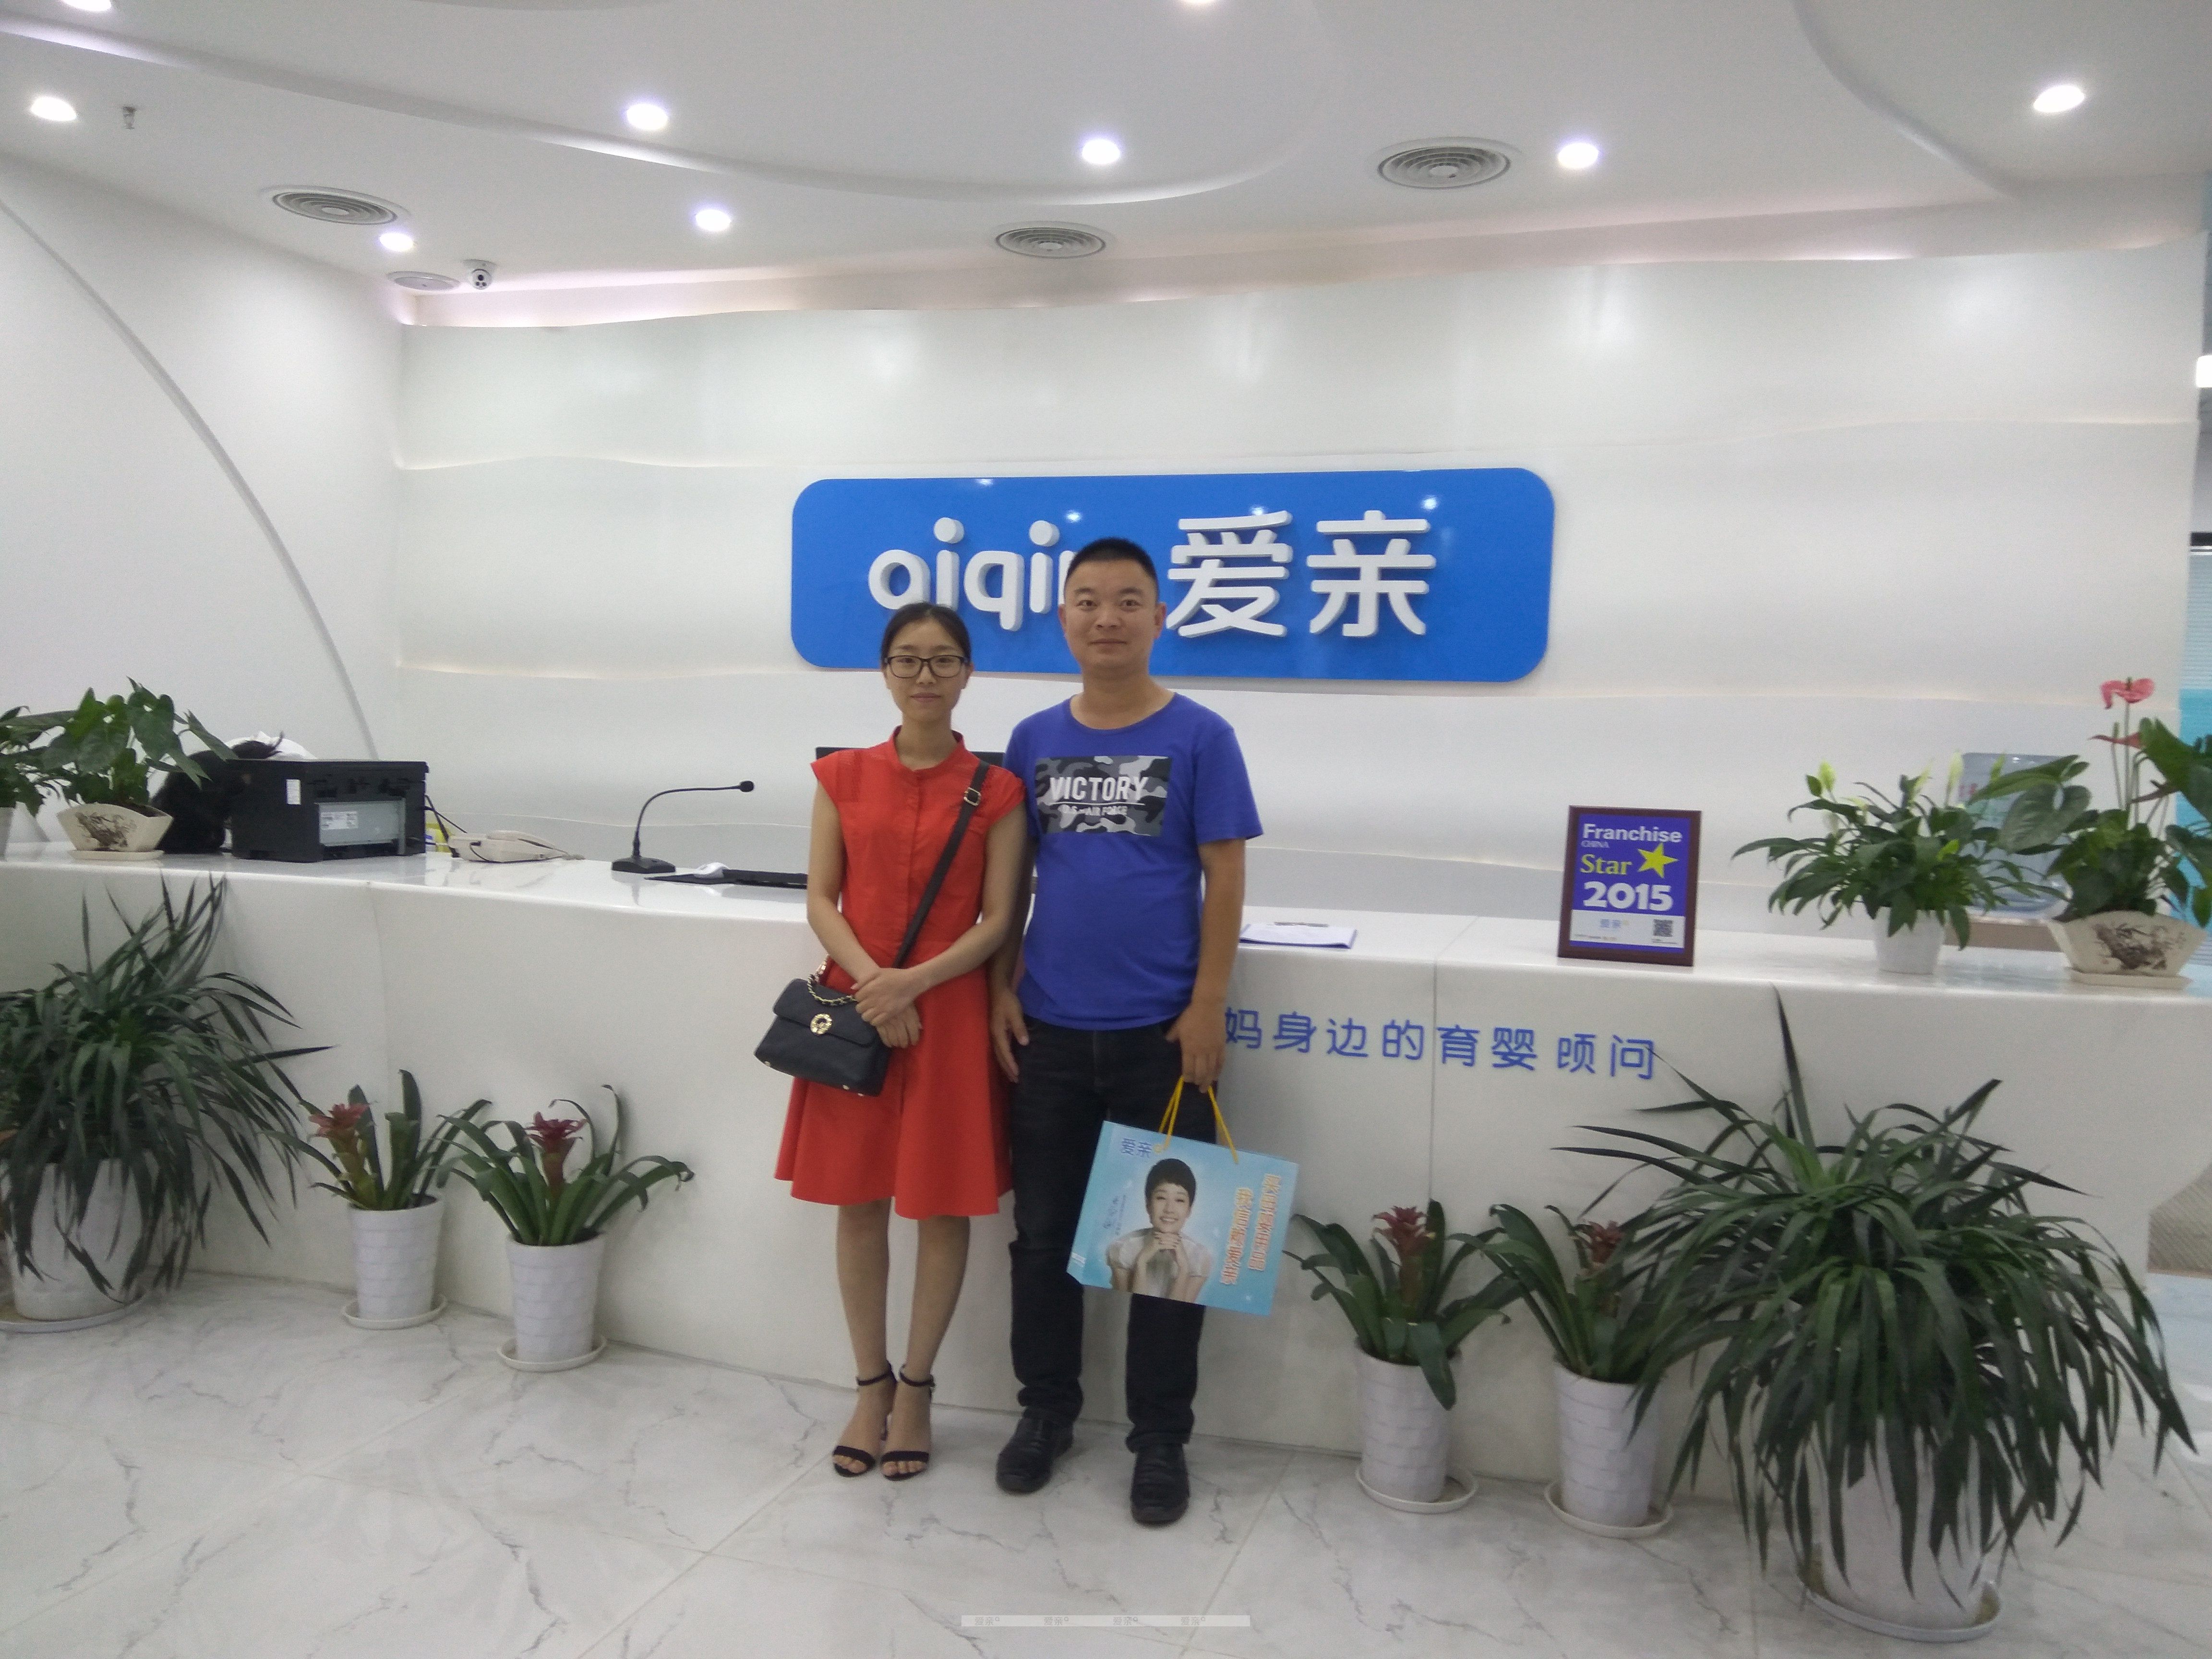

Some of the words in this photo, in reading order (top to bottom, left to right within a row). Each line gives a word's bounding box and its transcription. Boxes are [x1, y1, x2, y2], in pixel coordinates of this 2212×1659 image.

[868, 517, 1077, 631] aiqi
[1167, 510, 1436, 637] 爱亲
[1049, 776, 1149, 801] VICTORY
[1583, 823, 1683, 843] Franchise
[1580, 854, 1632, 875] Star
[1583, 881, 1673, 911] 2015
